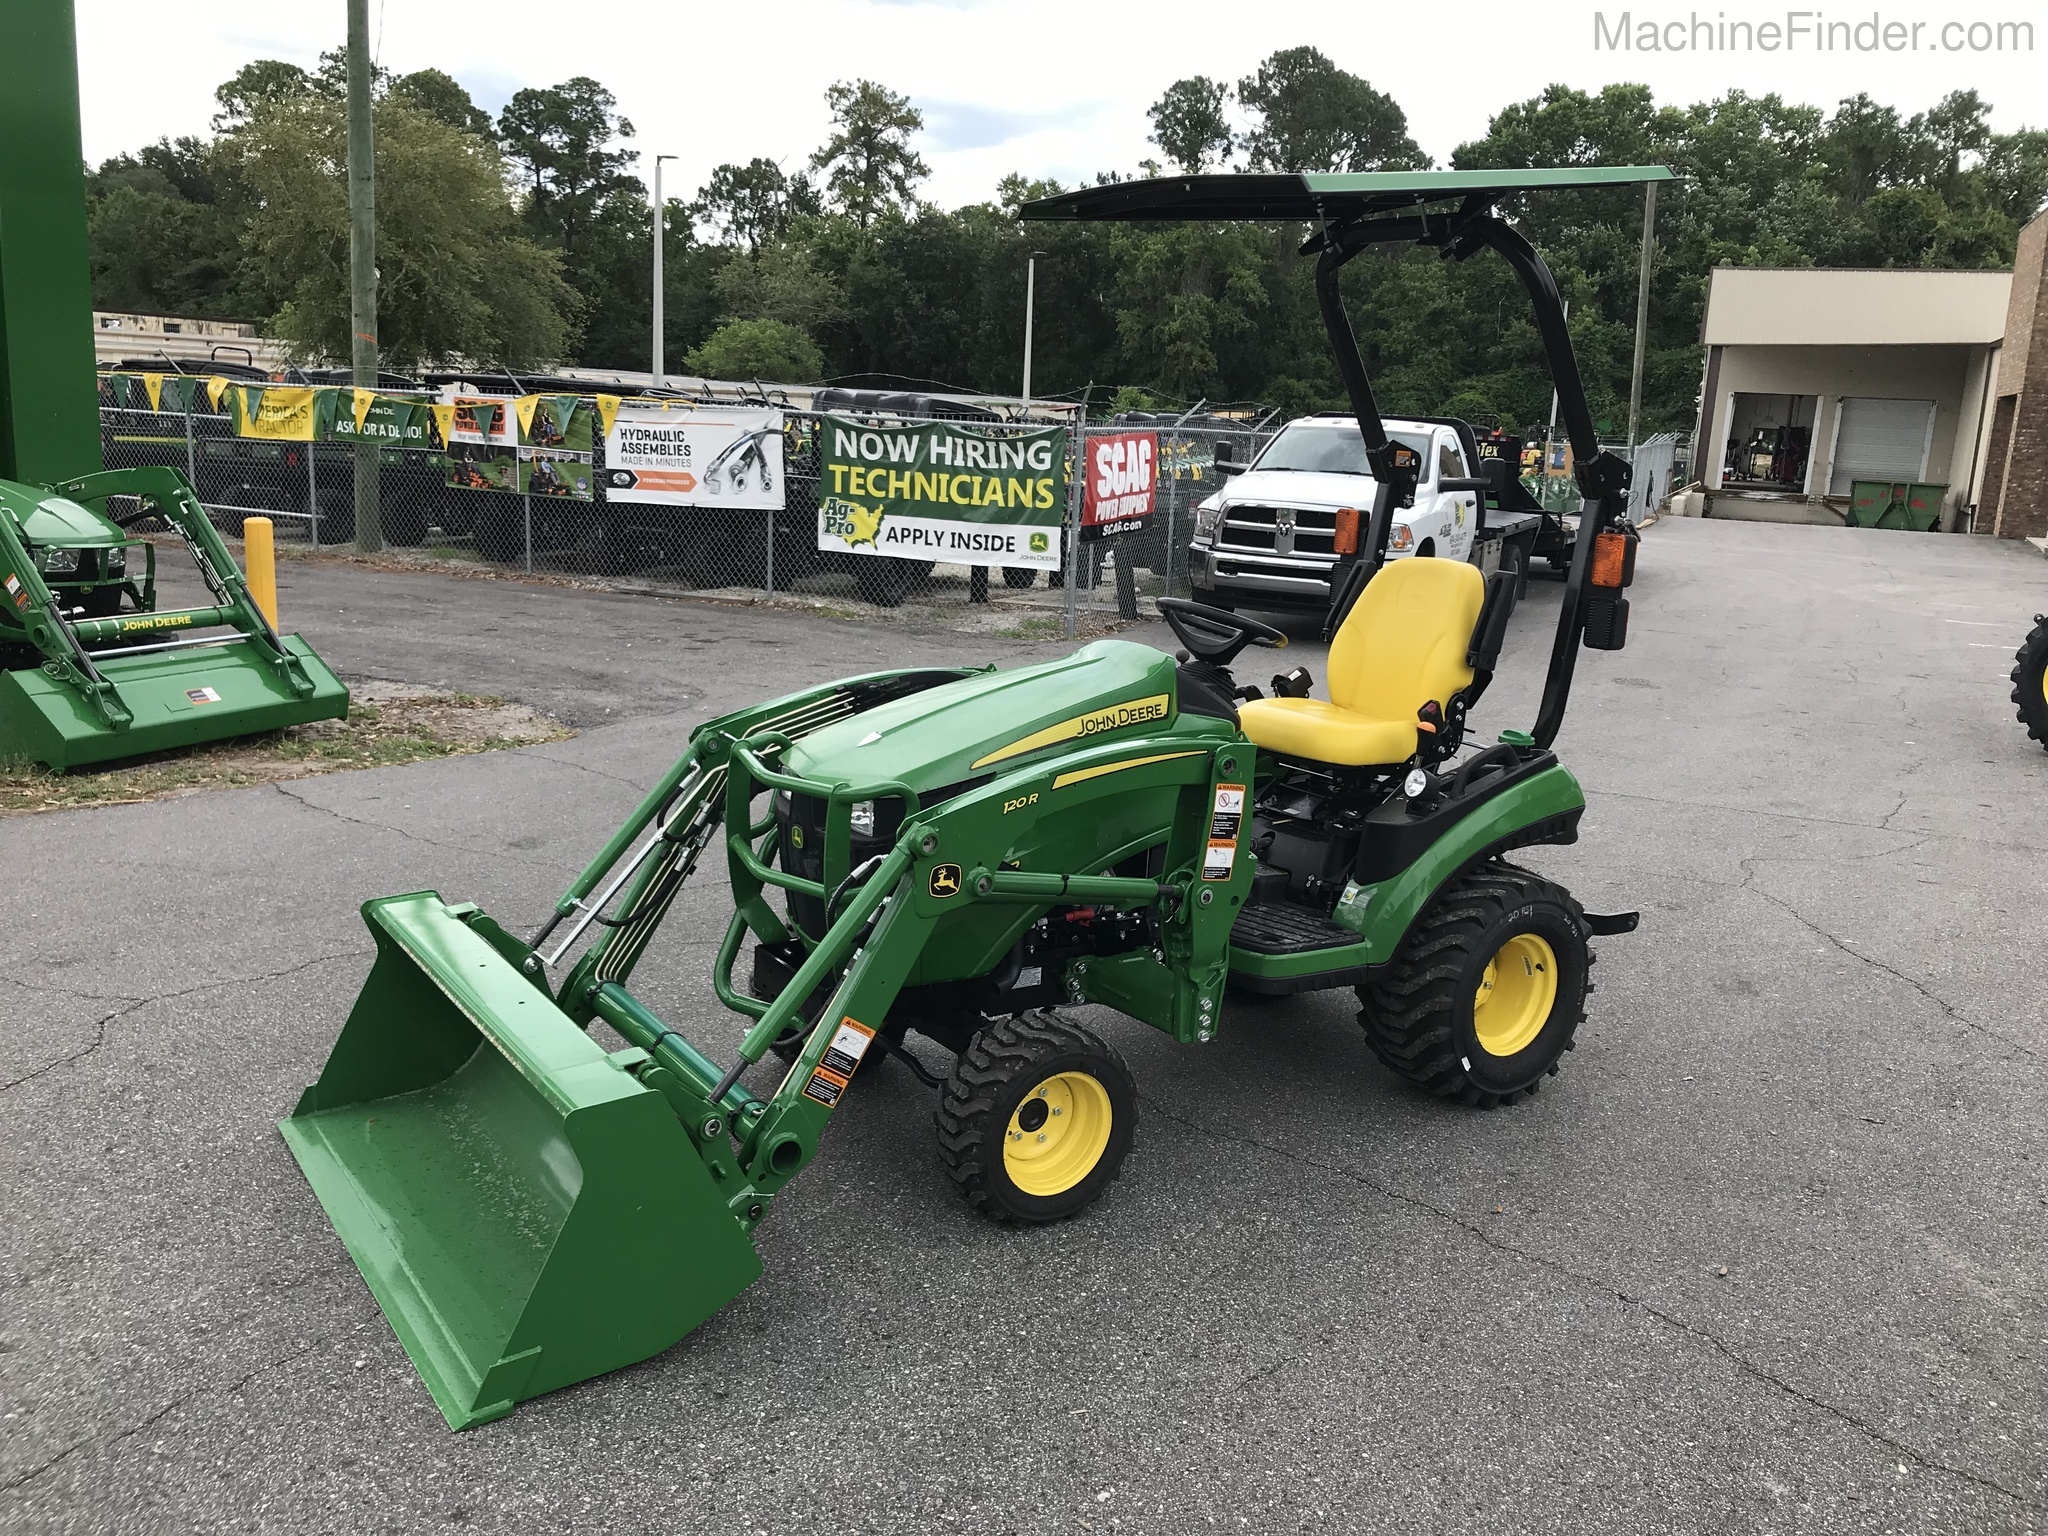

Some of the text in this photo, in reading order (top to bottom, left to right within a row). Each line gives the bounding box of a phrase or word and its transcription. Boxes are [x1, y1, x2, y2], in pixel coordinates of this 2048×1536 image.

[247, 404, 308, 419] MERICA'S
[336, 420, 356, 434] ASK
[379, 424, 387, 437] A
[620, 428, 685, 443] HYDRAULIC
[621, 442, 691, 457] ASSEMBLIES
[835, 428, 1052, 471] NOW HIRING
[621, 456, 692, 468] MADE IN MINUTES
[1096, 439, 1151, 498] SCAG
[828, 464, 1055, 509] TECHNICIANS
[1095, 498, 1119, 522] POWER
[824, 516, 856, 535] Pro
[886, 526, 1016, 553] APPLY INSIDE
[123, 615, 192, 632] JOHN DEERE
[1077, 703, 1163, 736] JOHN DEERE
